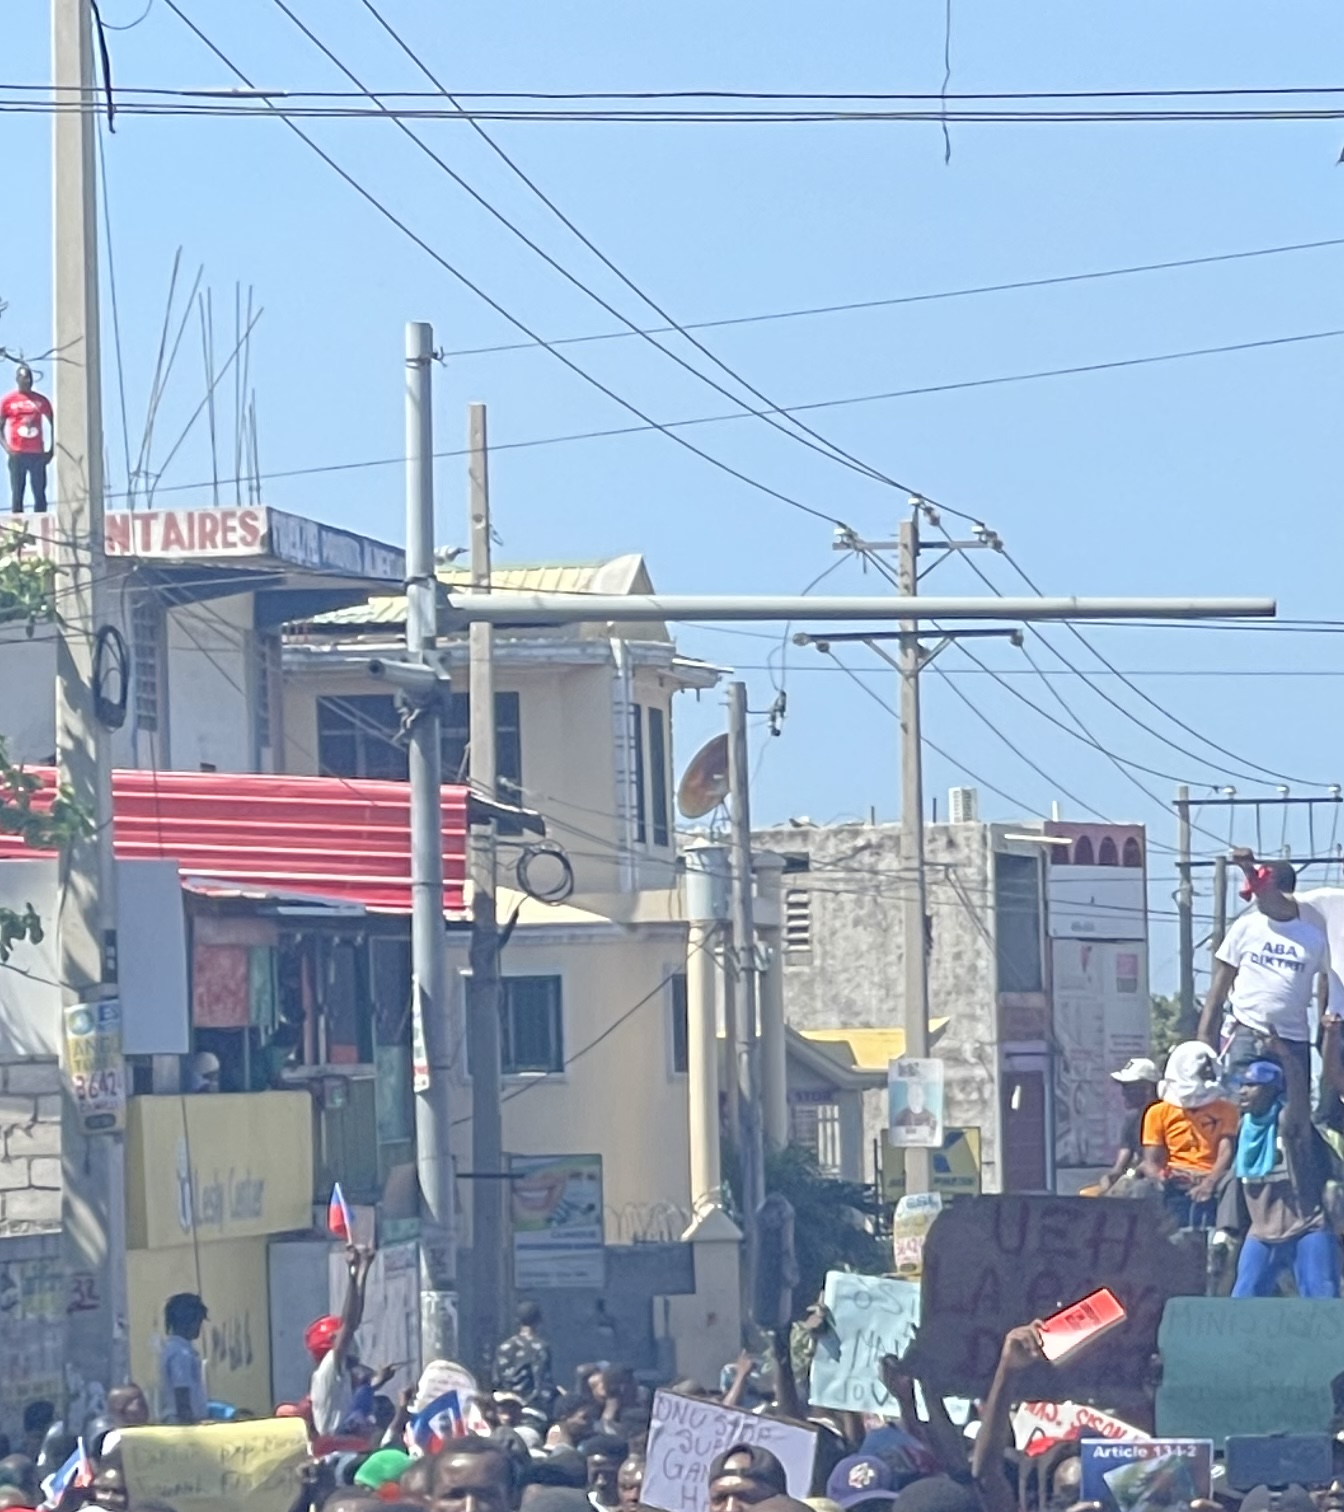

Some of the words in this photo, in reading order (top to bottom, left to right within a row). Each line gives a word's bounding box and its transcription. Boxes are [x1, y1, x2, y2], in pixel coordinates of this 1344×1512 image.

[1262, 942, 1298, 958] ABA
[656, 1398, 707, 1429] ONU
[1093, 1445, 1148, 1458] Article
